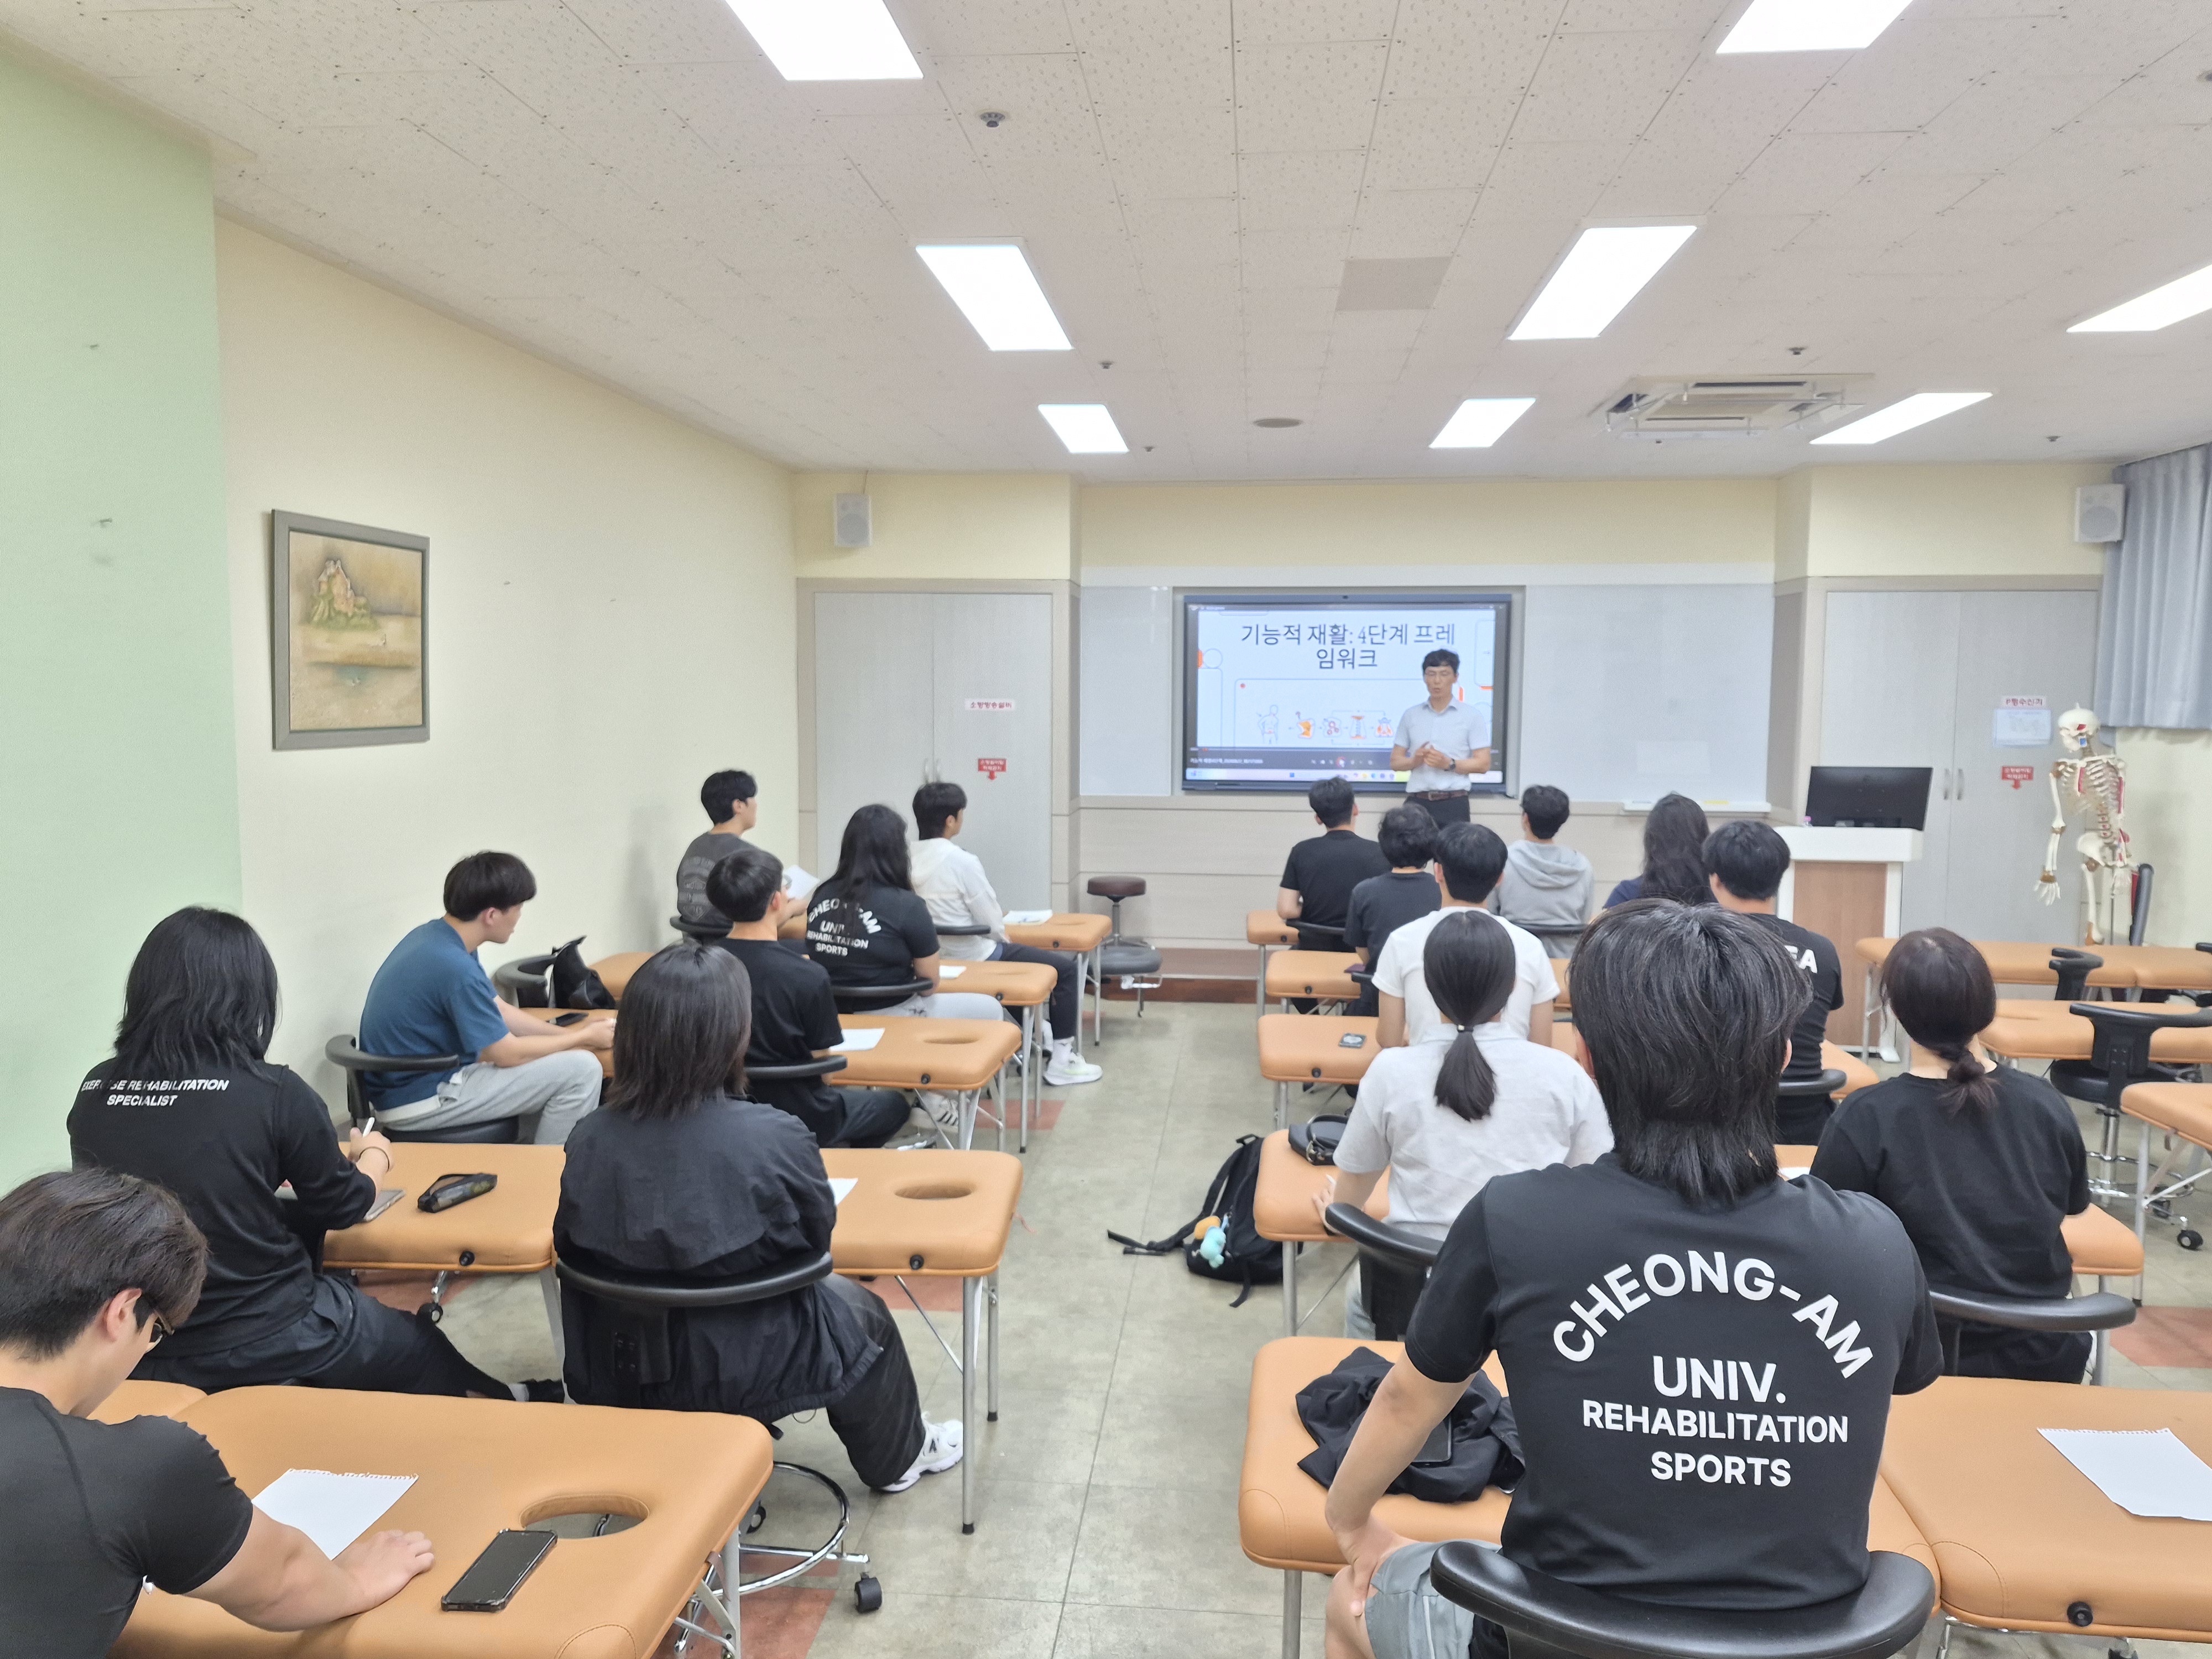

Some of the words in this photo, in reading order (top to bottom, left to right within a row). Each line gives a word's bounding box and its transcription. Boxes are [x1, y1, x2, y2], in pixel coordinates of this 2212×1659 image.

[1241, 624, 1301, 645] 기능적
[1307, 623, 1353, 645] 재활:
[1358, 623, 1408, 645] 4단계
[1413, 623, 1455, 645] 프레
[1316, 648, 1378, 670] 임워크
[807, 930, 869, 950] REHABILTATION
[815, 942, 848, 957] SPORTS
[81, 1079, 127, 1092] EXERSE
[127, 1079, 229, 1091] REHABILITATION
[107, 1094, 178, 1106] SPECIALIST
[1553, 1250, 1874, 1379] CHEONG-AM
[1652, 1355, 1787, 1404] UNIV.
[1583, 1399, 1848, 1443] REHABILITATION
[1651, 1451, 1791, 1487] SPORTS
